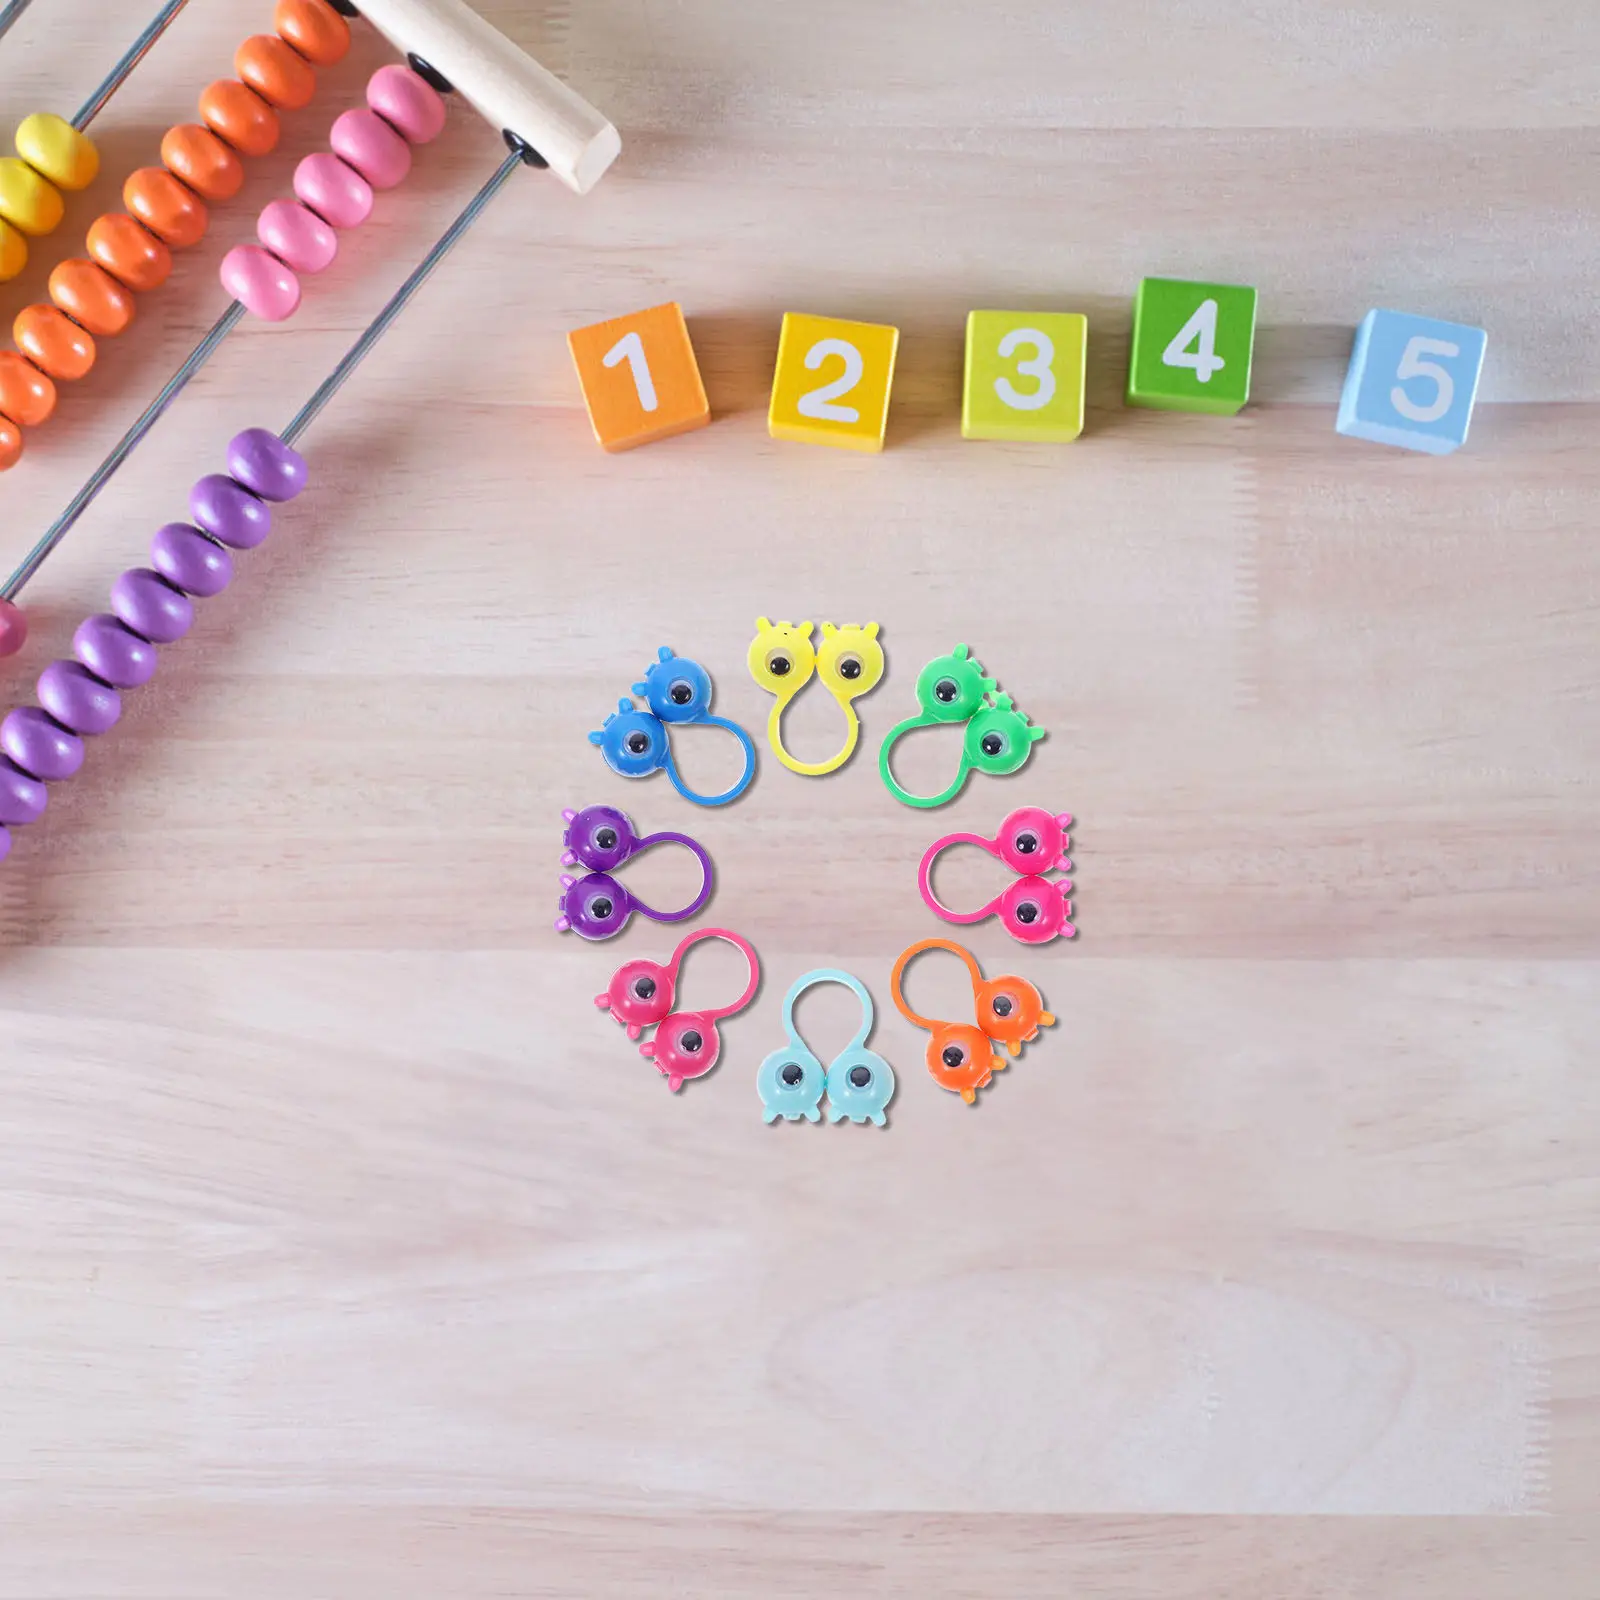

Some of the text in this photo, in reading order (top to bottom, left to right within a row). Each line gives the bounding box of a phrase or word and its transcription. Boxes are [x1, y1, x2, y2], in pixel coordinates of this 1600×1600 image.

[602, 332, 658, 411] 1
[797, 339, 863, 423] 2
[994, 328, 1056, 410] 3
[1162, 299, 1225, 383] 4
[1391, 337, 1458, 422] 5
